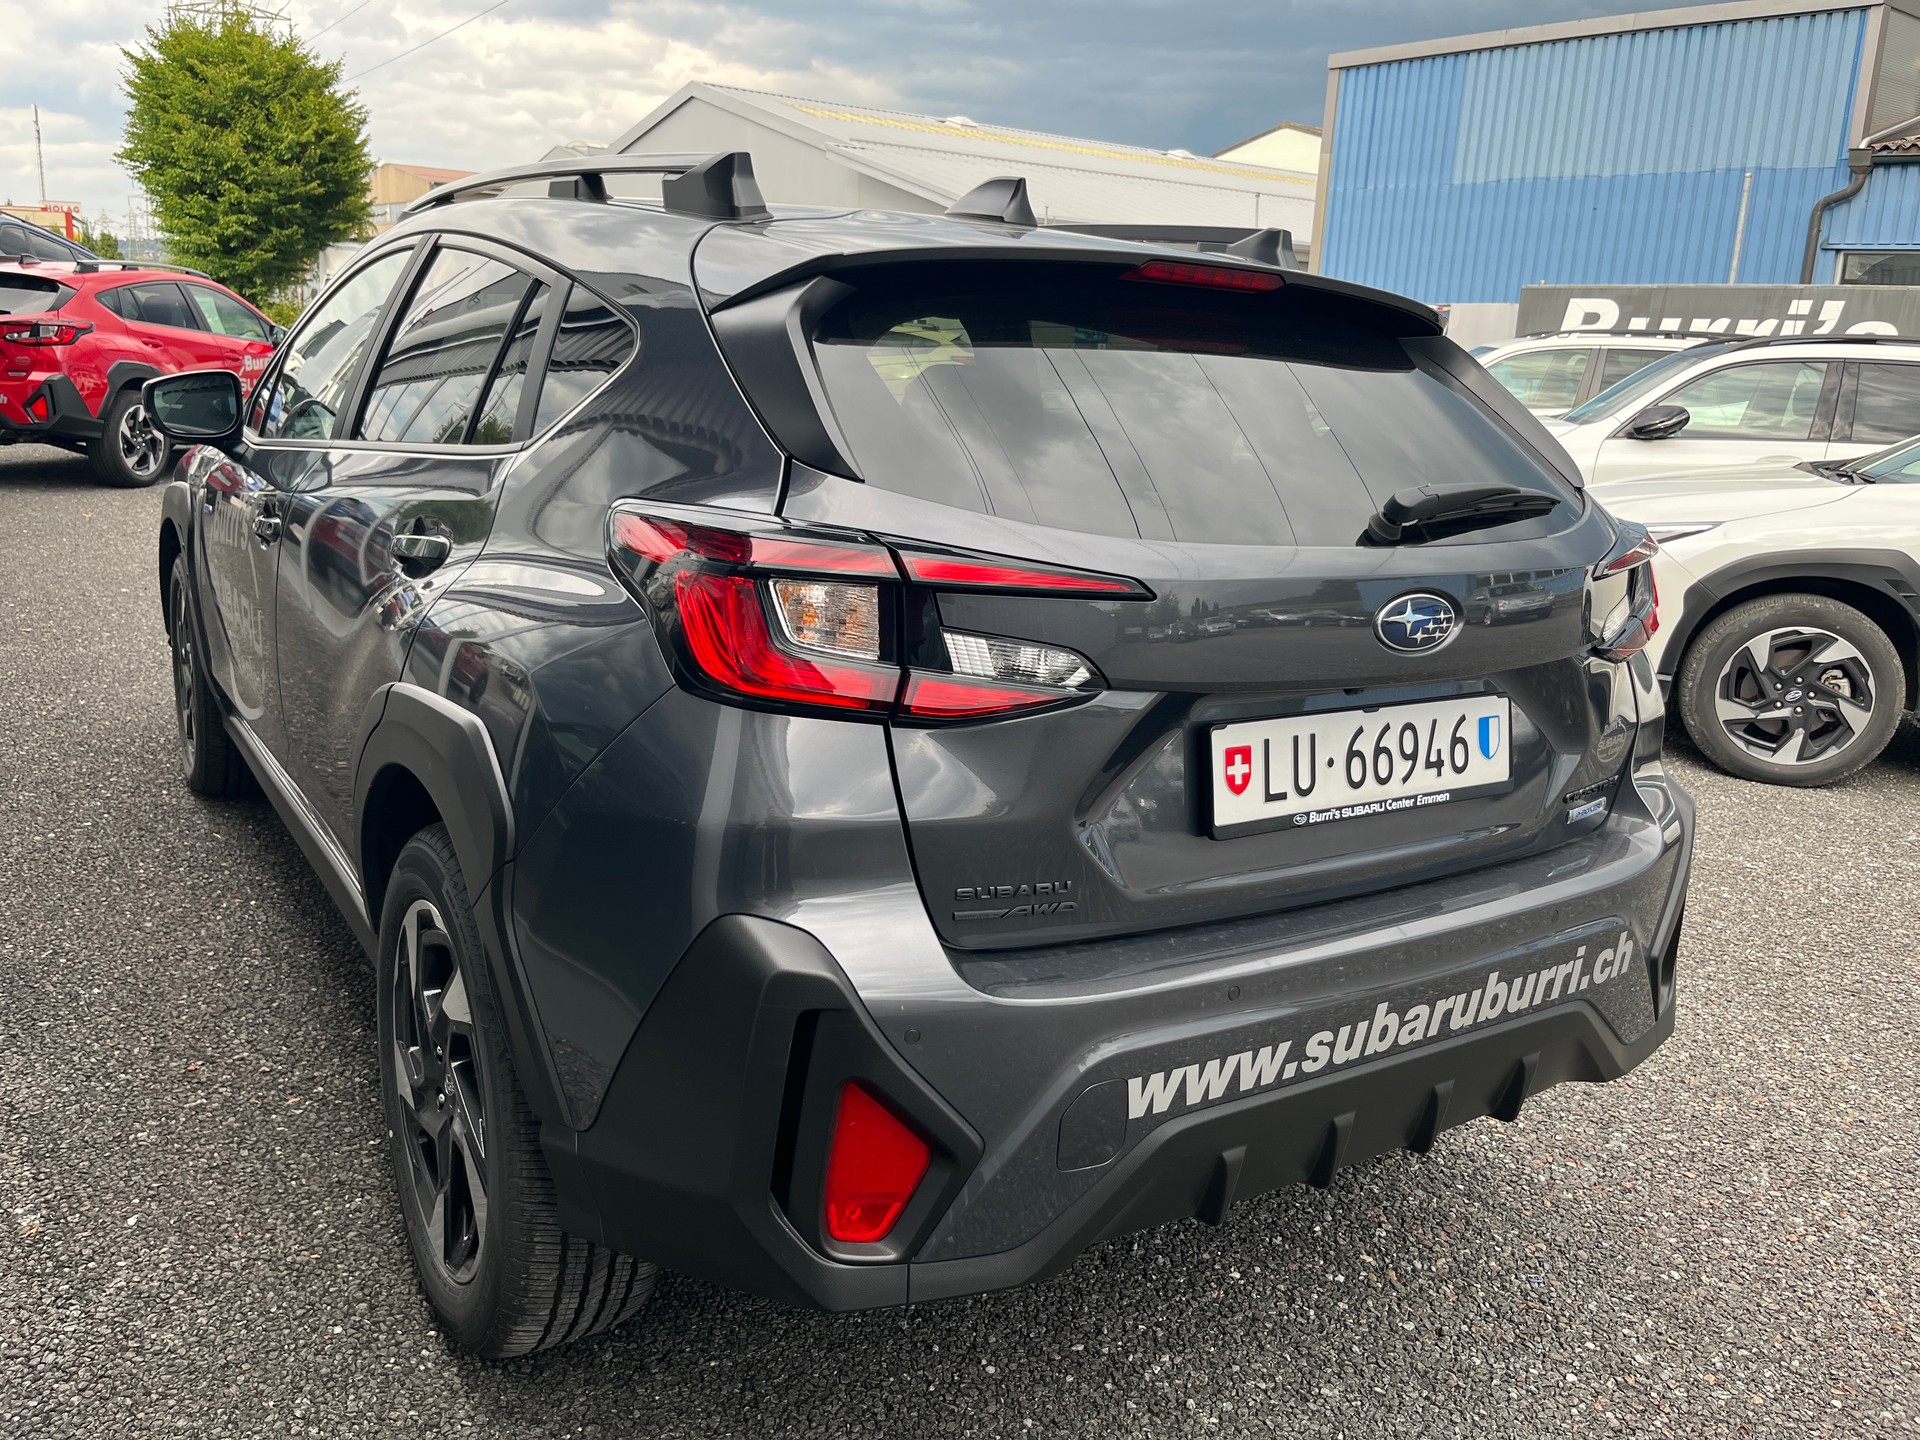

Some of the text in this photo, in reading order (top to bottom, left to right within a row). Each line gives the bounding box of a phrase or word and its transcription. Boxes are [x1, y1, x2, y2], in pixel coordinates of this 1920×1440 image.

[45, 204, 80, 213] HOLAG
[1309, 792, 1450, 823] Burri's SUBARU Center Emmen
[955, 880, 1072, 900] SUBARU
[1001, 901, 1078, 918] AWD
[1127, 931, 1634, 1119] www.subaruburri.ch
